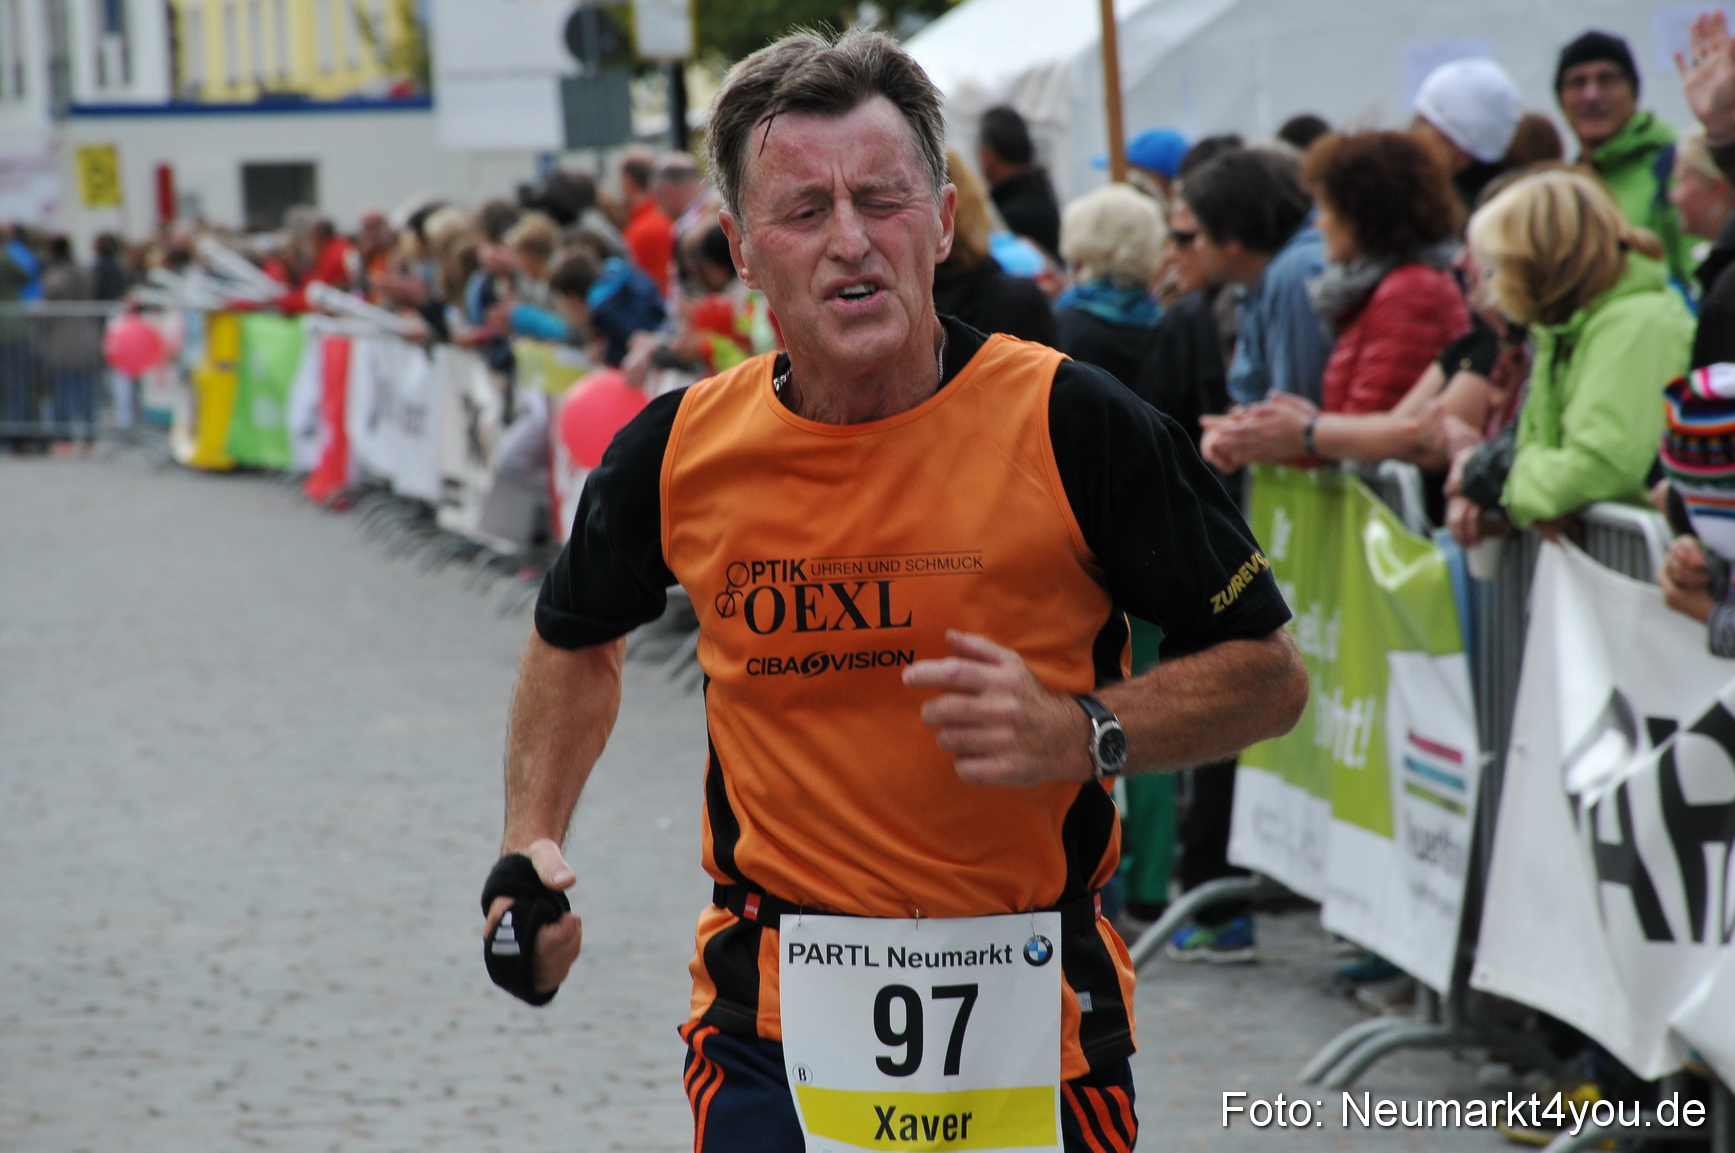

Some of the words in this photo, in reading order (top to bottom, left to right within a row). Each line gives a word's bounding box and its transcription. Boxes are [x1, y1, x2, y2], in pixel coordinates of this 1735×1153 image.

[811, 561, 863, 576] UHREN
[868, 559, 901, 573] UND
[905, 556, 984, 572] SCHMUCK
[743, 580, 913, 635] OEXL
[746, 656, 800, 676] CIBA
[830, 649, 914, 672] VISION
[788, 942, 880, 967] PARTL
[887, 943, 1013, 968] Neumarkt
[873, 983, 979, 1077] 97
[873, 1104, 973, 1142] Xaver
